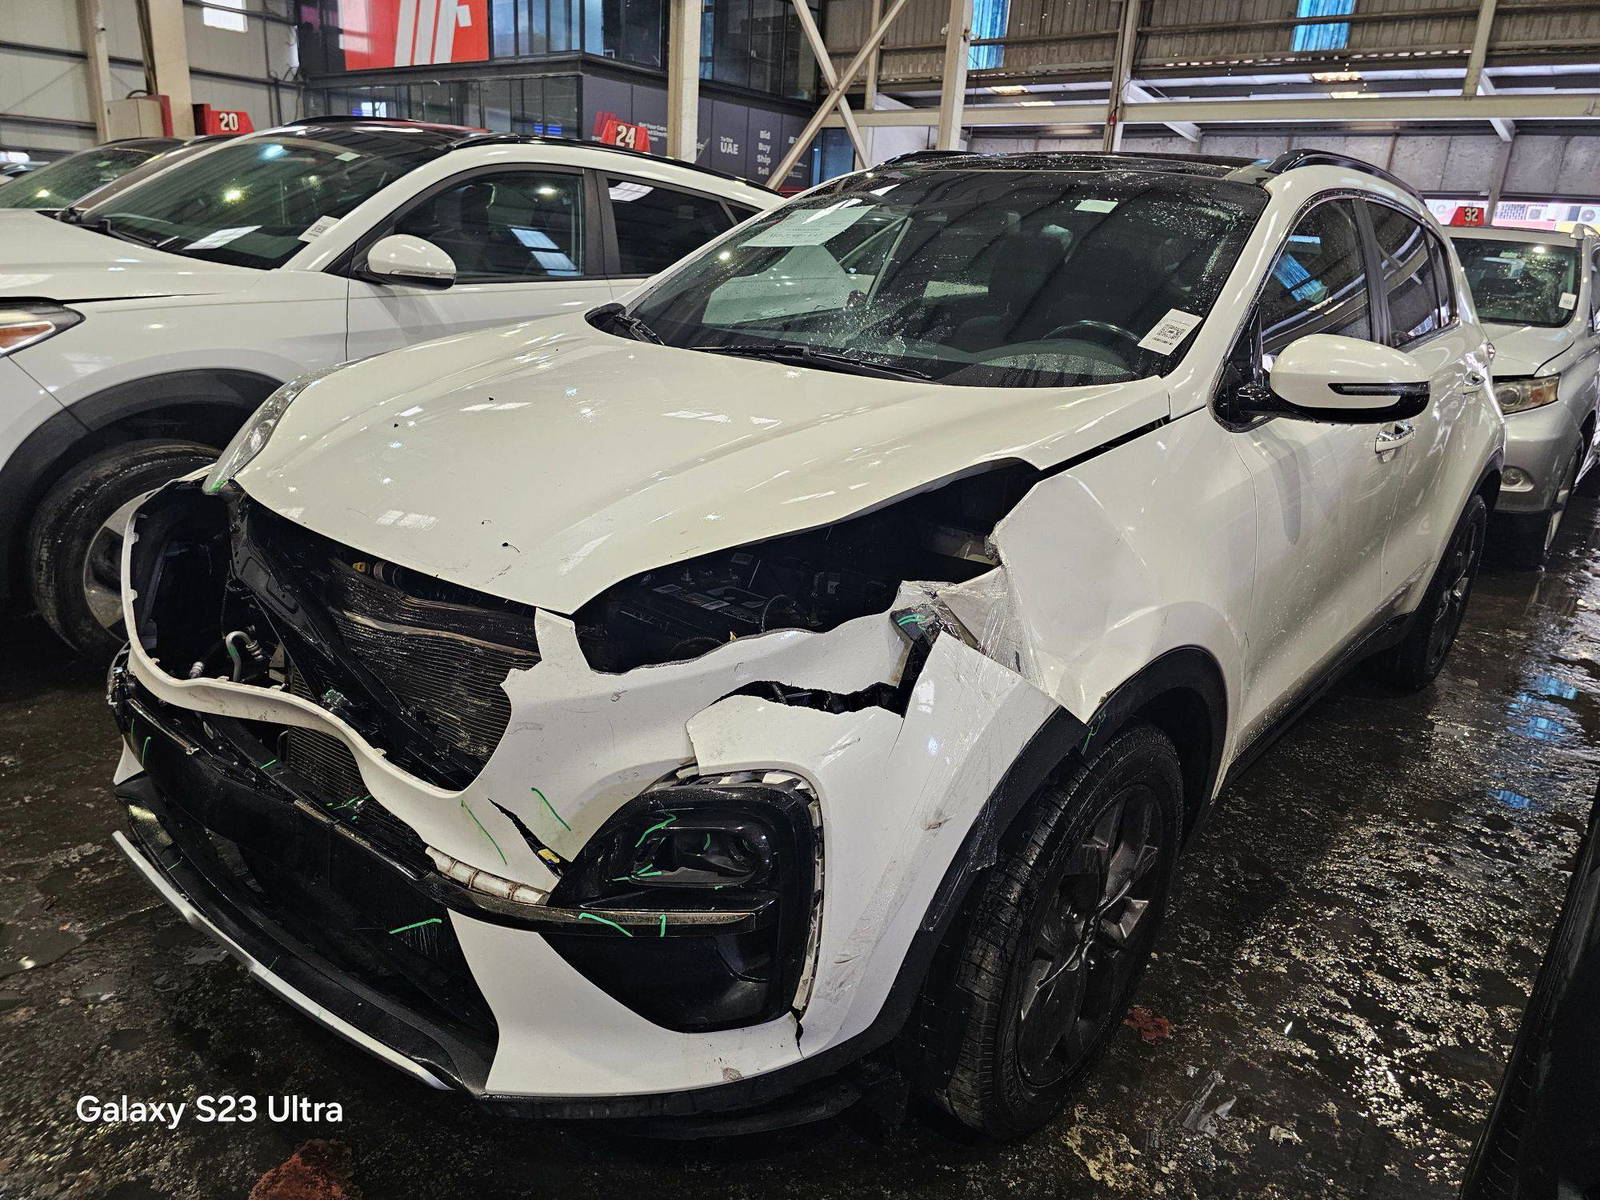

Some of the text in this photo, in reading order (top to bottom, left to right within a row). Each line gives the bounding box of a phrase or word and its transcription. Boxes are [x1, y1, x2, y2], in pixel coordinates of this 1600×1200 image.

[219, 112, 239, 131] 20
[616, 125, 636, 149] 24
[759, 130, 771, 140] Bid
[720, 142, 739, 155] UAE
[758, 142, 771, 154] Buy
[757, 154, 771, 166] Ship
[758, 166, 770, 176] Sell
[1464, 207, 1478, 222] 32
